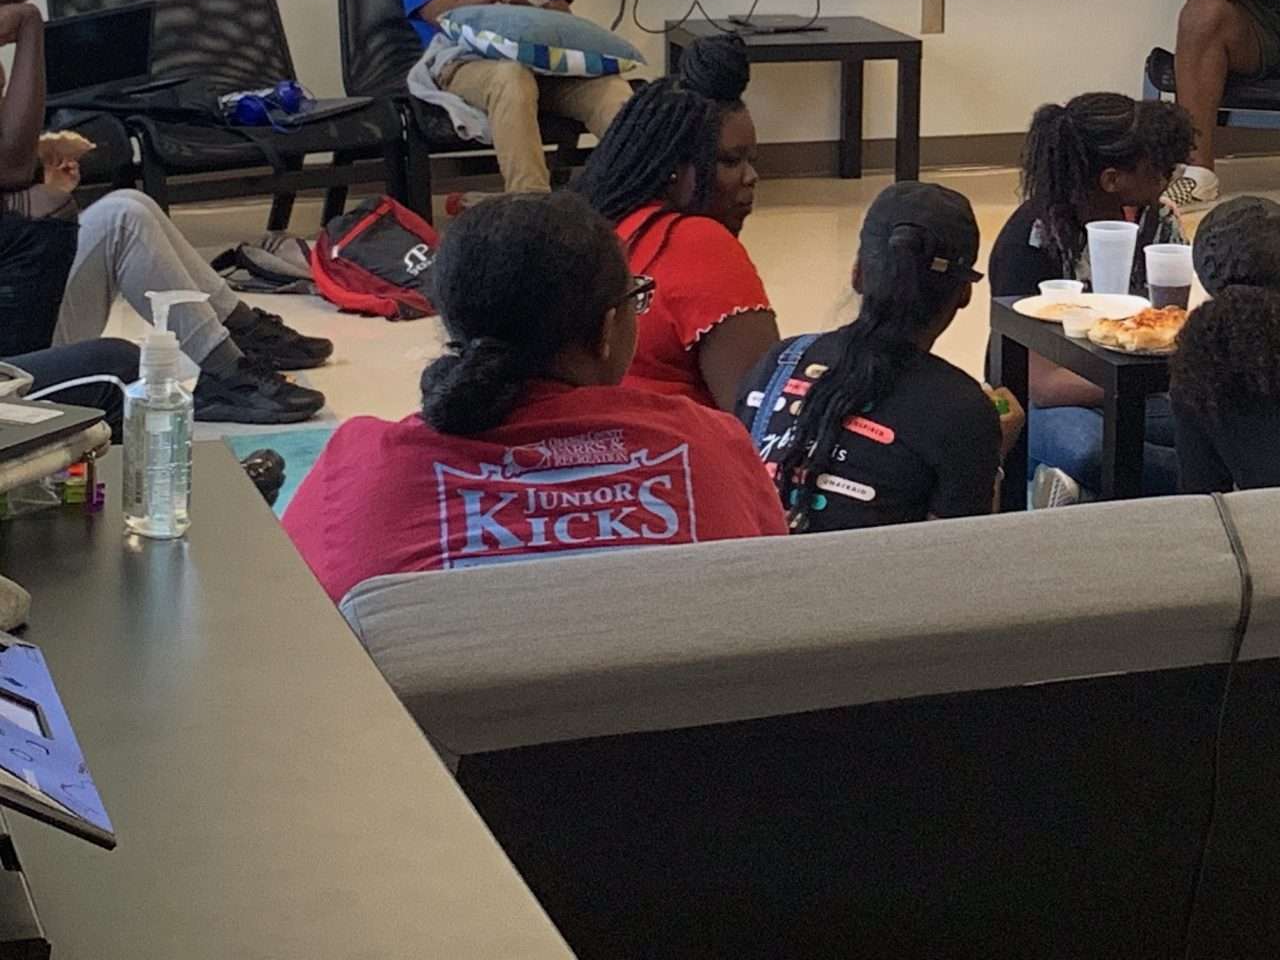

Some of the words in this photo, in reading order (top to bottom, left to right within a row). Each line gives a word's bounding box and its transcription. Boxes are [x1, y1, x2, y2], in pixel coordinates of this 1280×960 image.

[550, 440, 608, 456] PARKS
[610, 438, 627, 452] &
[831, 444, 848, 461] is
[553, 451, 629, 468] RECREATION
[524, 482, 635, 514] JUNIOR
[457, 474, 679, 553] KICKS
